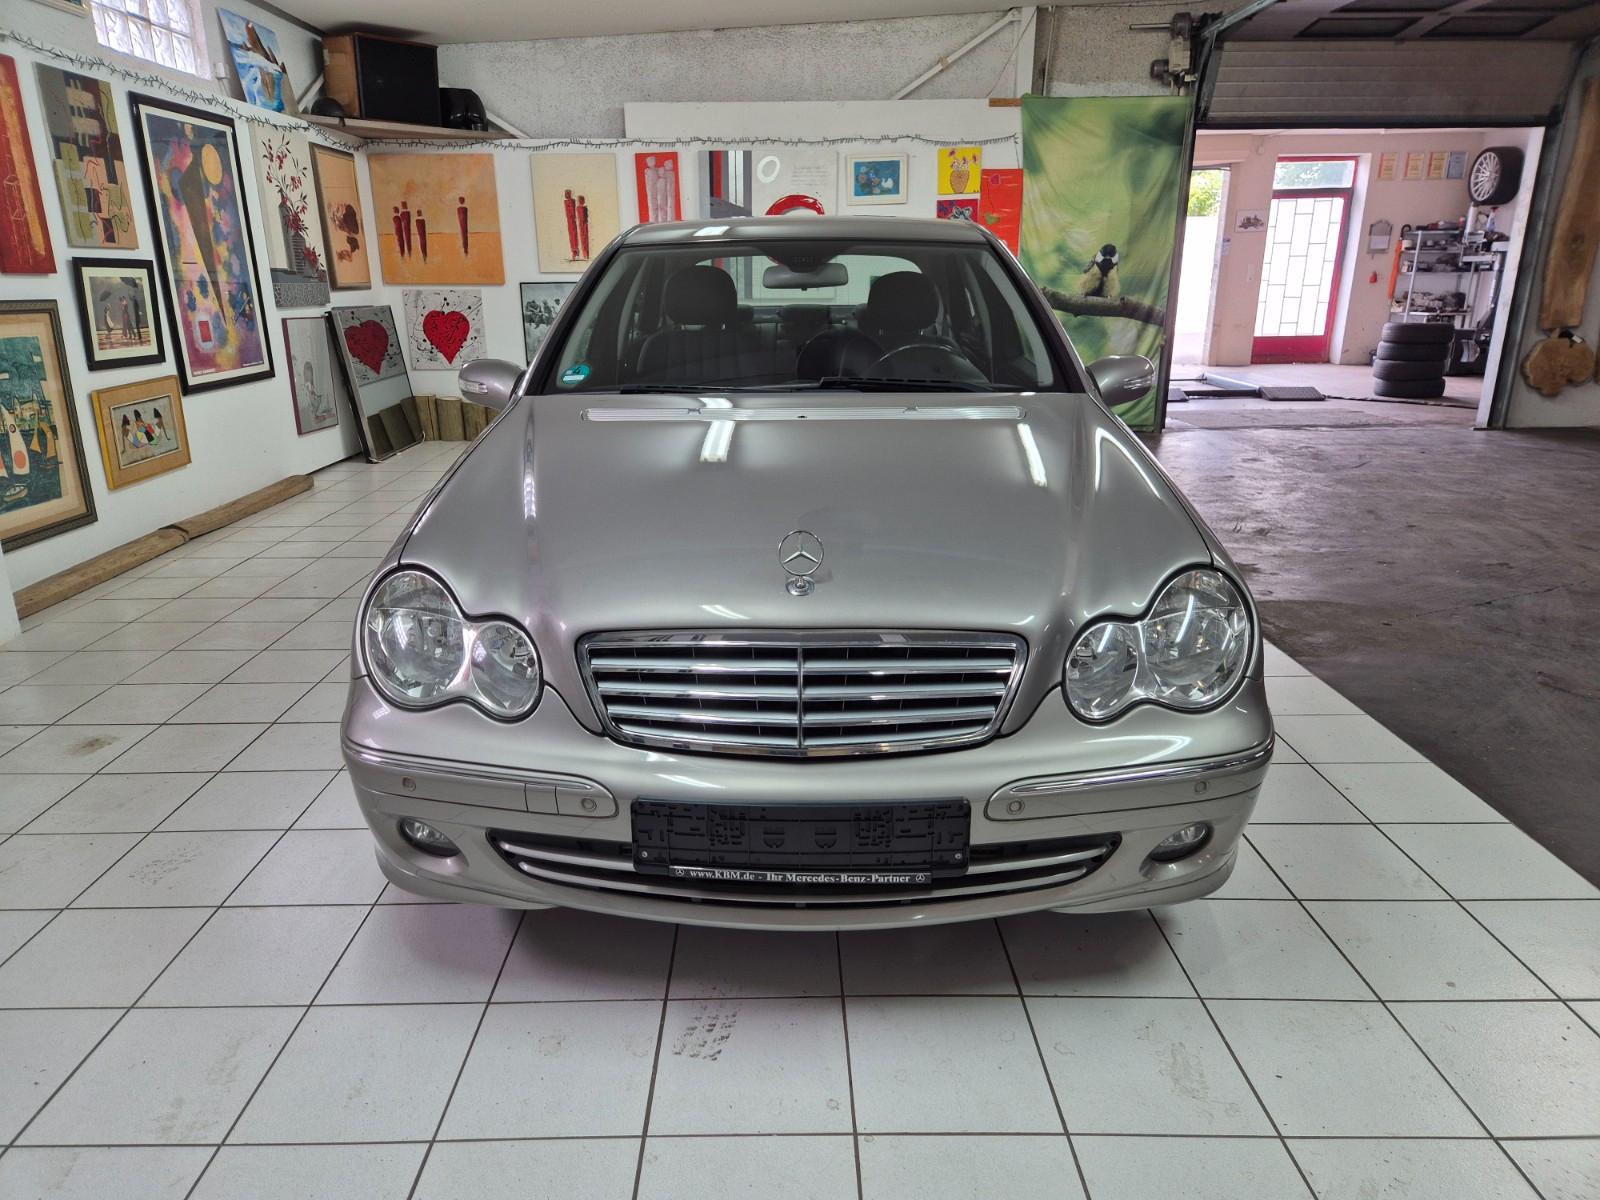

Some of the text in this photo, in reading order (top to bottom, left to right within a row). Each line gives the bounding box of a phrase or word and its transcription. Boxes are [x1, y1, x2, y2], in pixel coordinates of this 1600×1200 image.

[689, 869, 755, 881] www.KBM.de
[766, 872, 784, 882] Ihr
[786, 873, 911, 883] Mercedes-Benz-Partner
